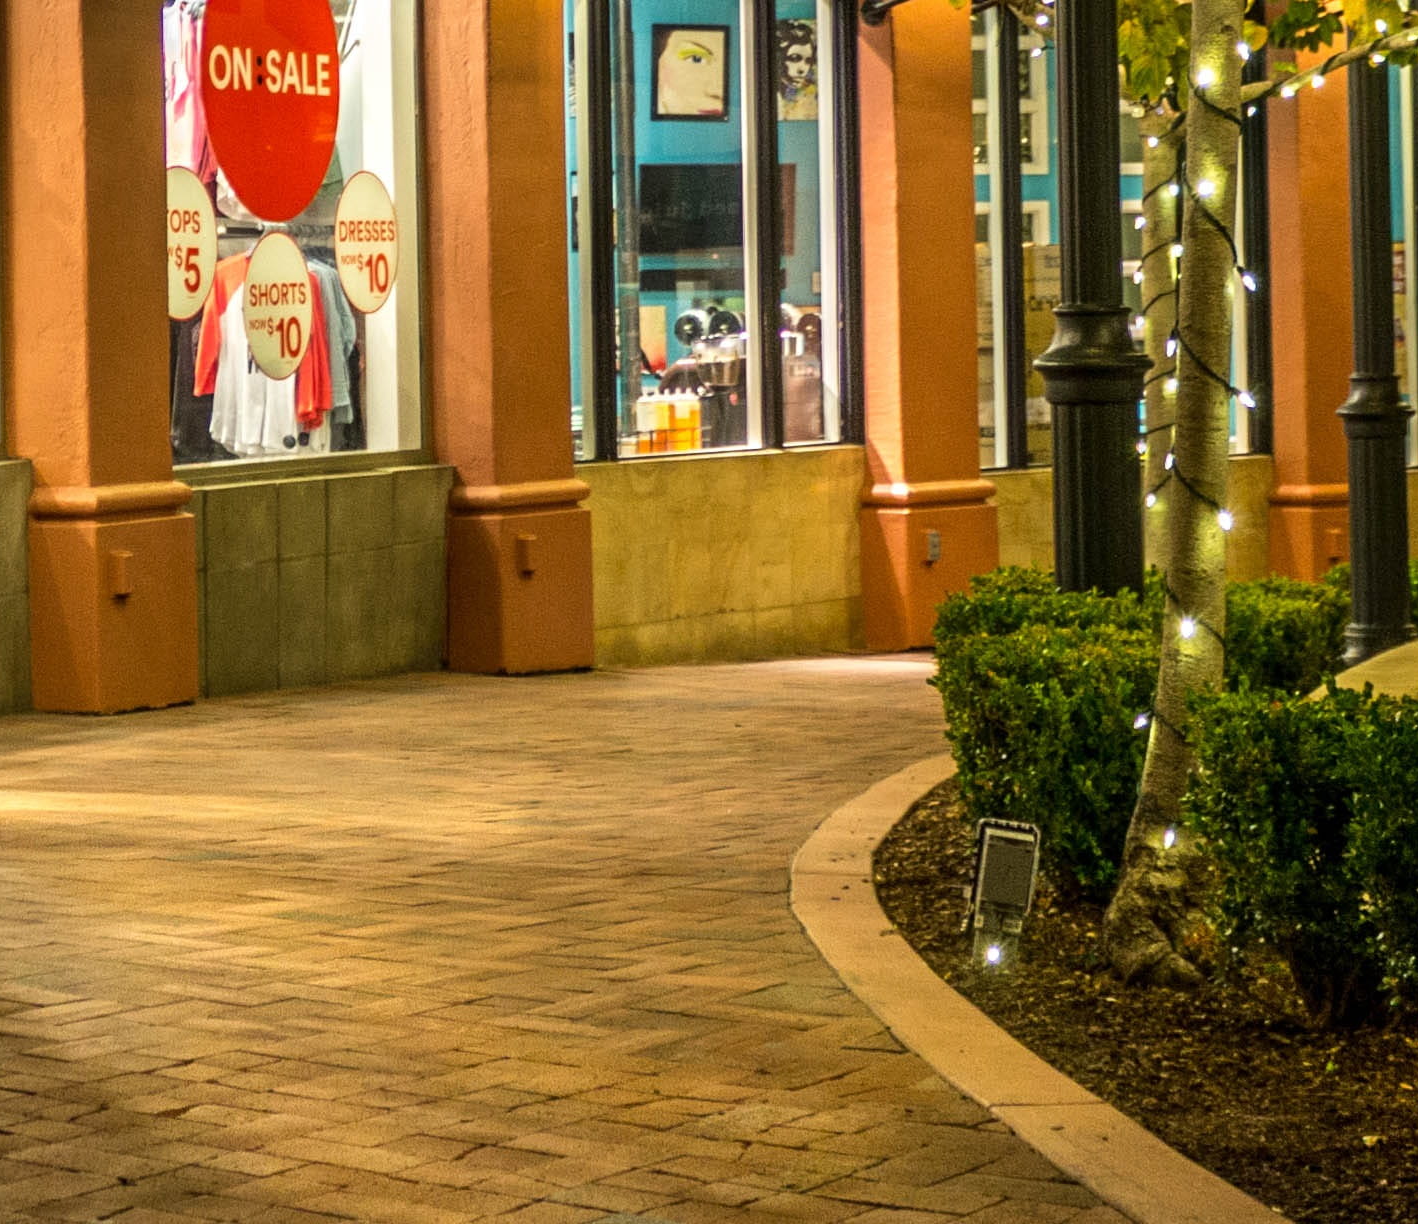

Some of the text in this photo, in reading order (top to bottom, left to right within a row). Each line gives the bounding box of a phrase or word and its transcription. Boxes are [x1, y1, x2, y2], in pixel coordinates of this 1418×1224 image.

[209, 44, 330, 96] ON SALE
[167, 209, 201, 233] OPS
[339, 220, 395, 242] DRESSES
[249, 283, 306, 307] SHORTS
